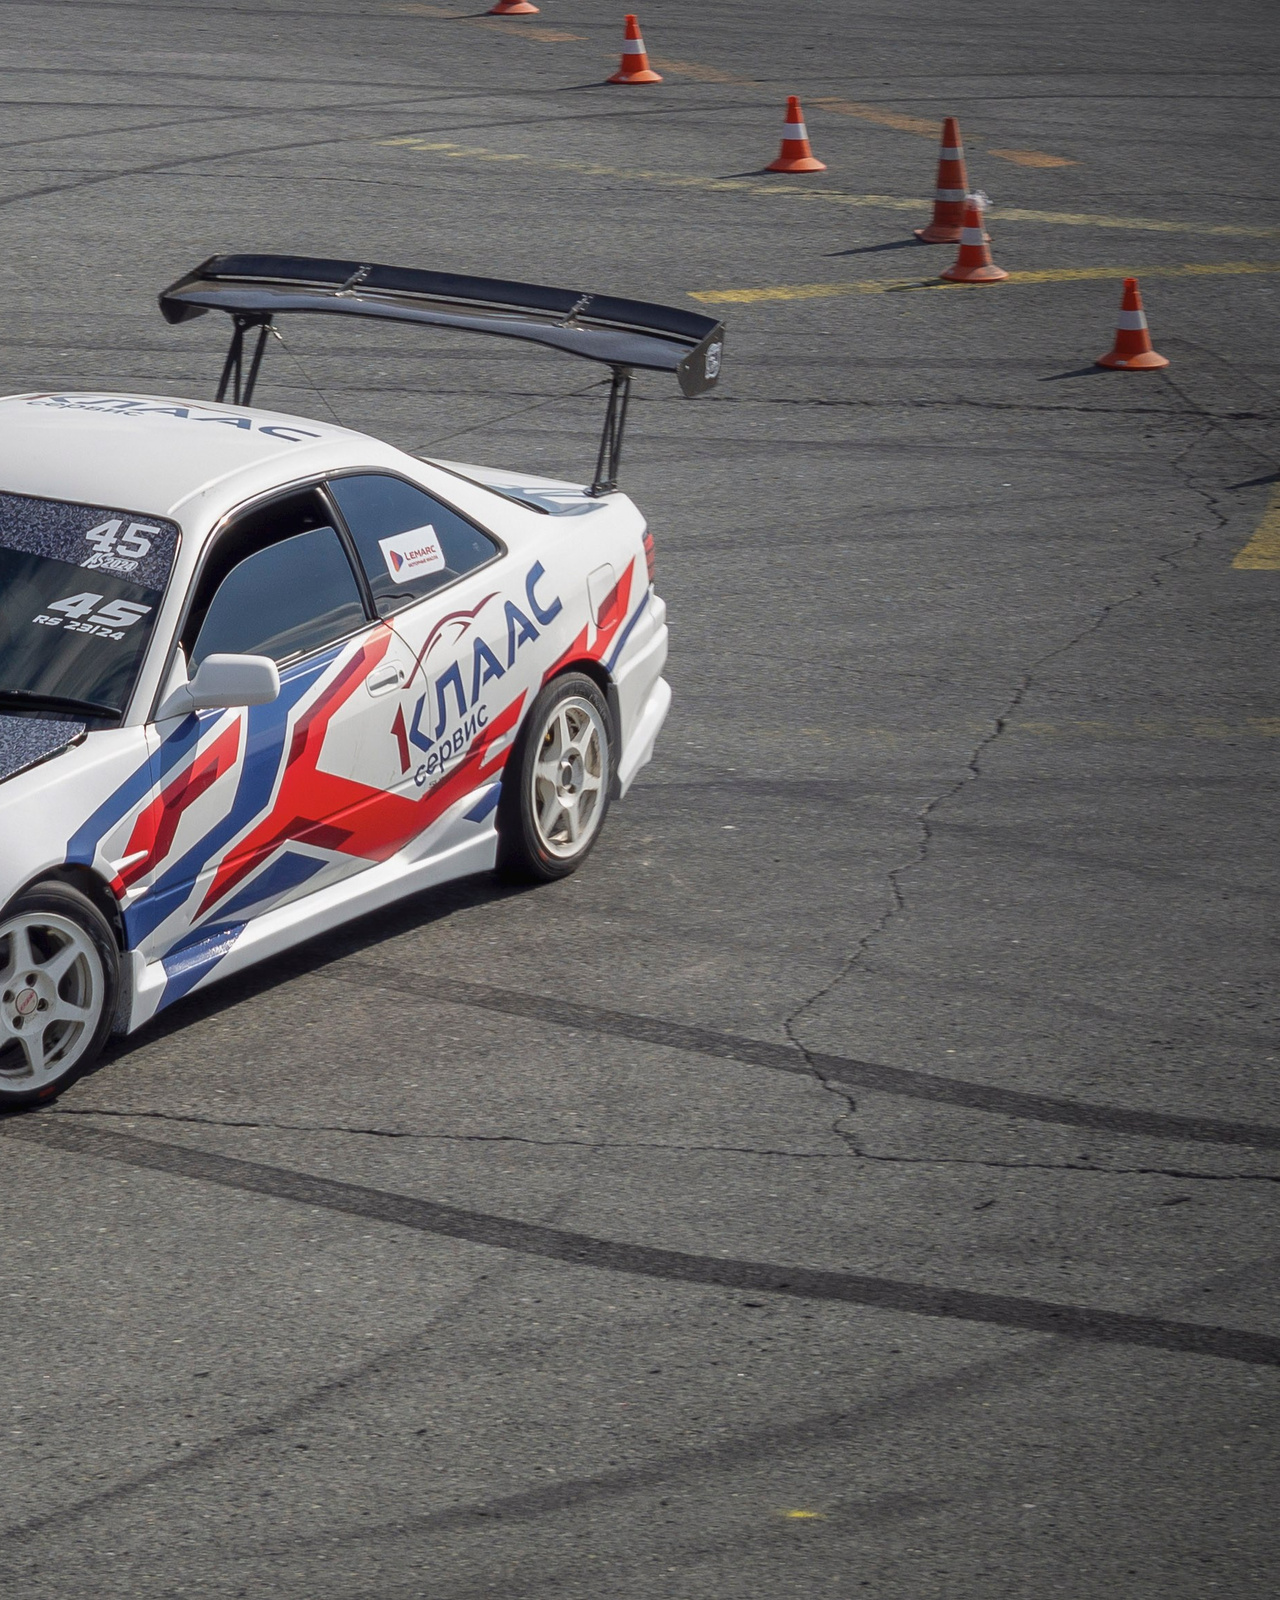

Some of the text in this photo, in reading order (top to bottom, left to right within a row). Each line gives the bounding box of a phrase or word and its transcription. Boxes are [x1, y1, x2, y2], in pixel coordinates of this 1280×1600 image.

[86, 519, 161, 559] 45
[404, 544, 437, 561] LEMARC
[32, 614, 64, 626] RS
[47, 592, 153, 628] 45
[414, 704, 489, 787] сервис
